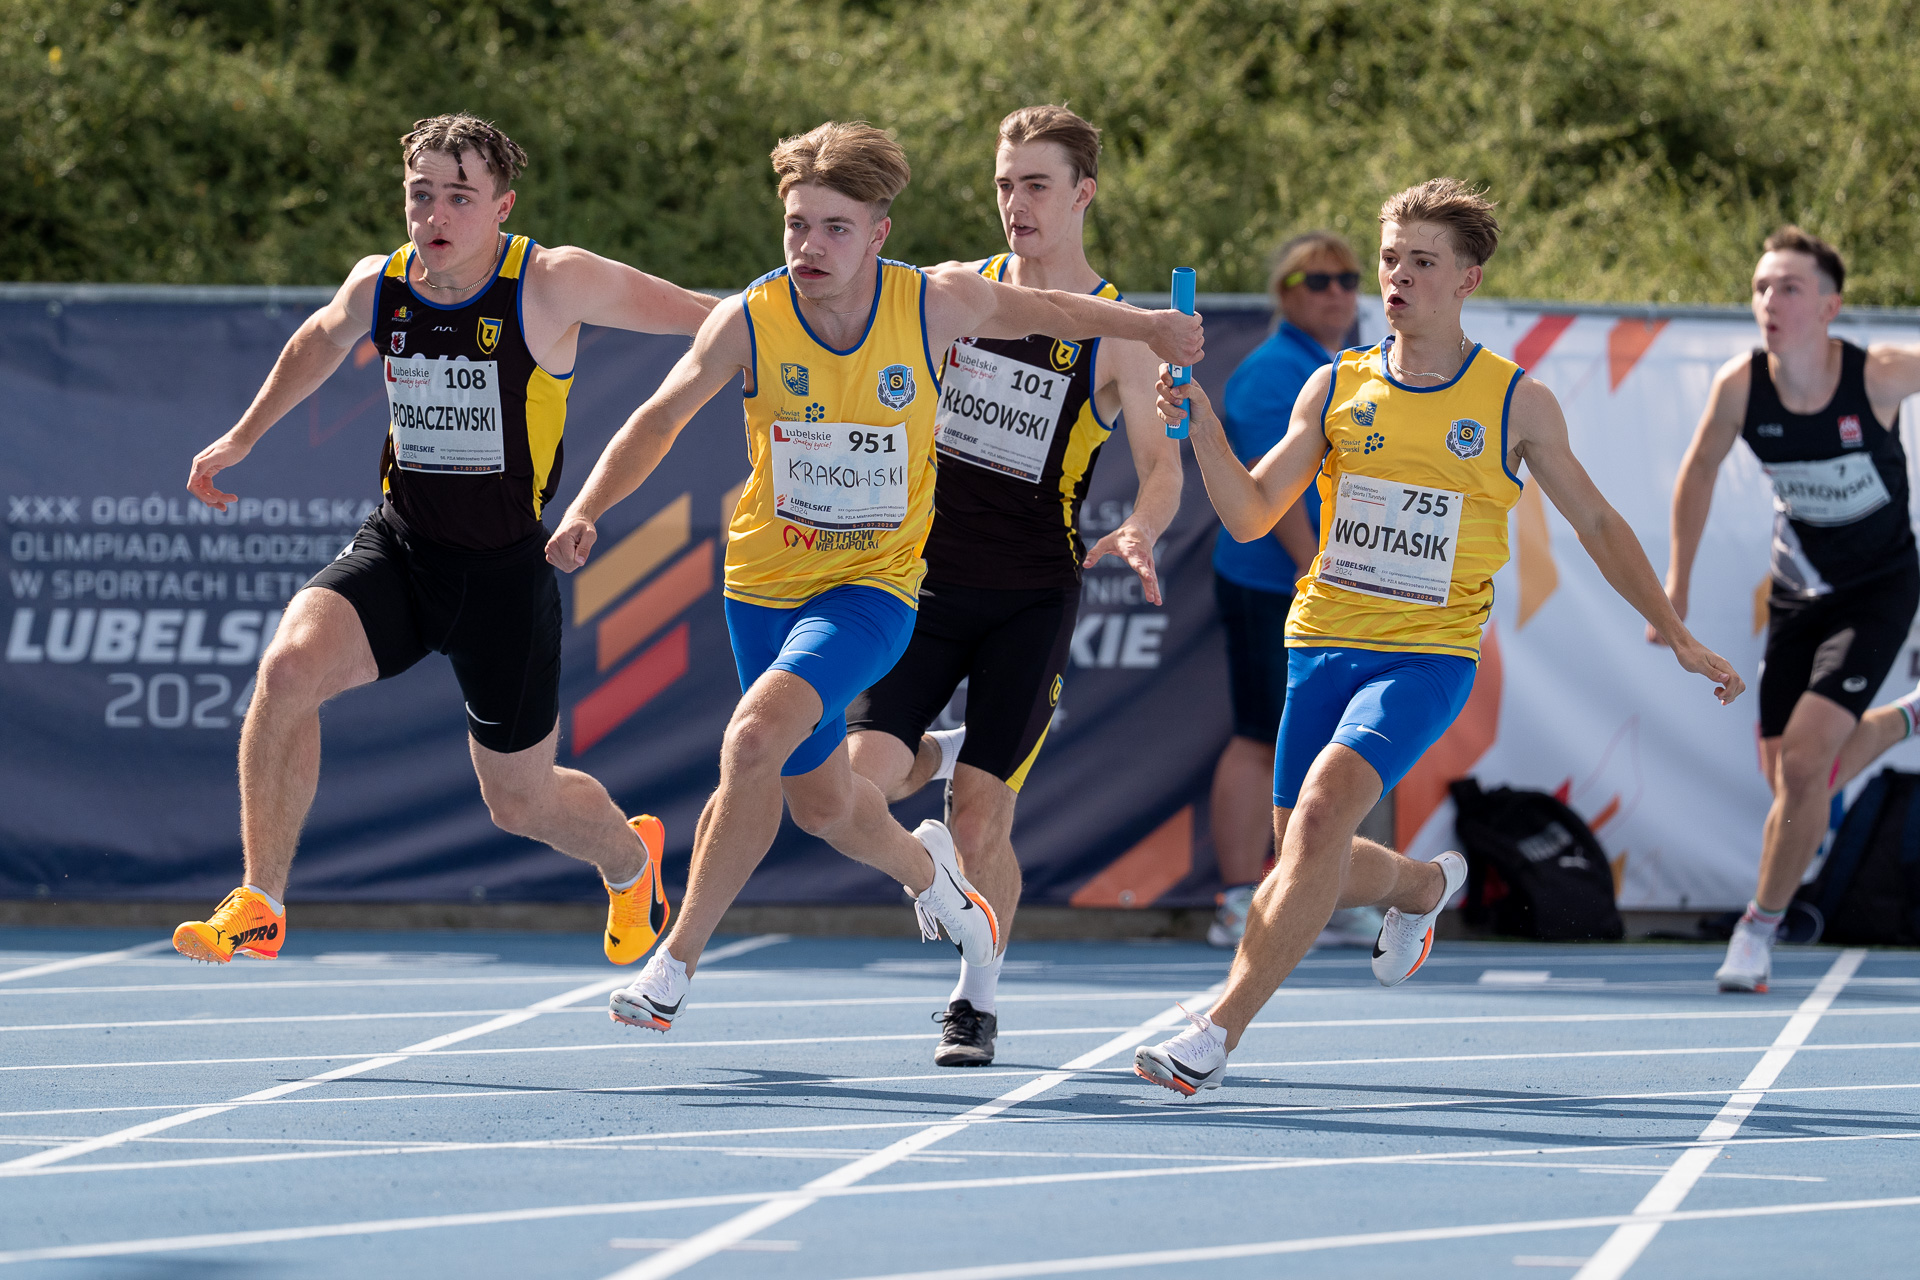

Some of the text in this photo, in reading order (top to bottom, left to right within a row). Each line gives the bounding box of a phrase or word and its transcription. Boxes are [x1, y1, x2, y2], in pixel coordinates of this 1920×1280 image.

[444, 367, 487, 390] 108
[892, 376, 901, 386] S
[1010, 369, 1054, 401] 101
[392, 401, 496, 432] ROBACZEWSKI
[942, 385, 1050, 442] KŁOSOWSKI
[848, 430, 896, 453] 951
[943, 426, 979, 445] LUBELSKIE
[1462, 428, 1471, 438] S
[402, 443, 435, 453] LUBELSKIE
[402, 451, 418, 459] 2024
[788, 457, 904, 489] KRAKOWSKI
[7, 496, 83, 524] XXX
[789, 505, 808, 516] 2024
[790, 497, 833, 513] LUBELSKIE
[1401, 488, 1450, 518] 755
[794, 516, 814, 526] LUBLIN
[11, 531, 194, 563] OLIMPIADA
[1335, 517, 1450, 562] WOJTASIK
[1335, 558, 1377, 574] LUBELSKIE
[1335, 566, 1353, 577] 2024
[9, 568, 45, 600] W
[51, 569, 228, 600] SPORTACH
[1392, 589, 1433, 601] 5-7.07.2024
[6, 607, 281, 666] LUBELS
[104, 672, 257, 729] 202
[228, 923, 278, 953] NITRO
